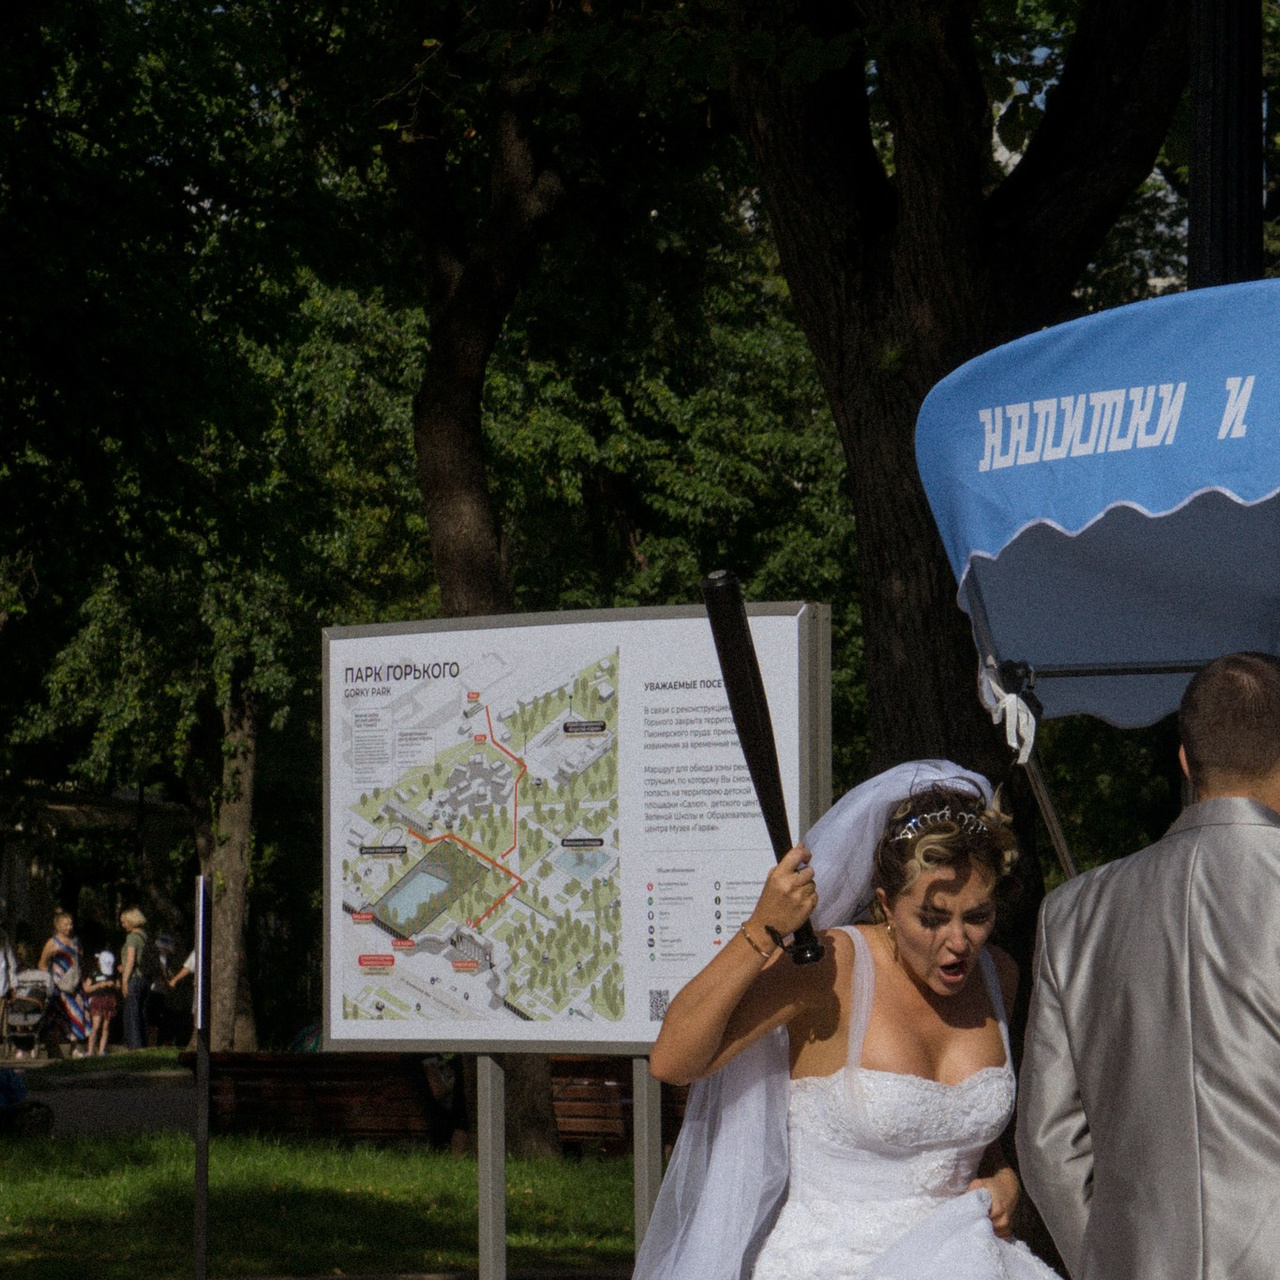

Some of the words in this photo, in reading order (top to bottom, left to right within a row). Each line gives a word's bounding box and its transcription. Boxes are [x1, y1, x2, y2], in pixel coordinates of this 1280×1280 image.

[978, 382, 1187, 472] НАПИТКИ
[1218, 376, 1256, 440] И
[344, 665, 383, 683] ПАРК
[386, 662, 460, 681] ГОРЬКОГО
[644, 680, 698, 691] УВАЖАЕМЫЕ
[699, 680, 725, 689] ПОСЕ
[344, 688, 370, 698] GORKY
[371, 687, 392, 697] PARK
[677, 705, 732, 715] реконструкцие
[705, 717, 735, 725] террито
[714, 728, 738, 736] прино
[644, 765, 675, 774] Маршрут
[677, 765, 689, 773] для
[721, 774, 731, 782] Вы
[733, 775, 753, 783] смож
[644, 789, 671, 797] попасть
[682, 788, 722, 797] территорию
[707, 810, 763, 820] Образовательно
[645, 825, 668, 833] центра
[670, 824, 691, 834] Музея
